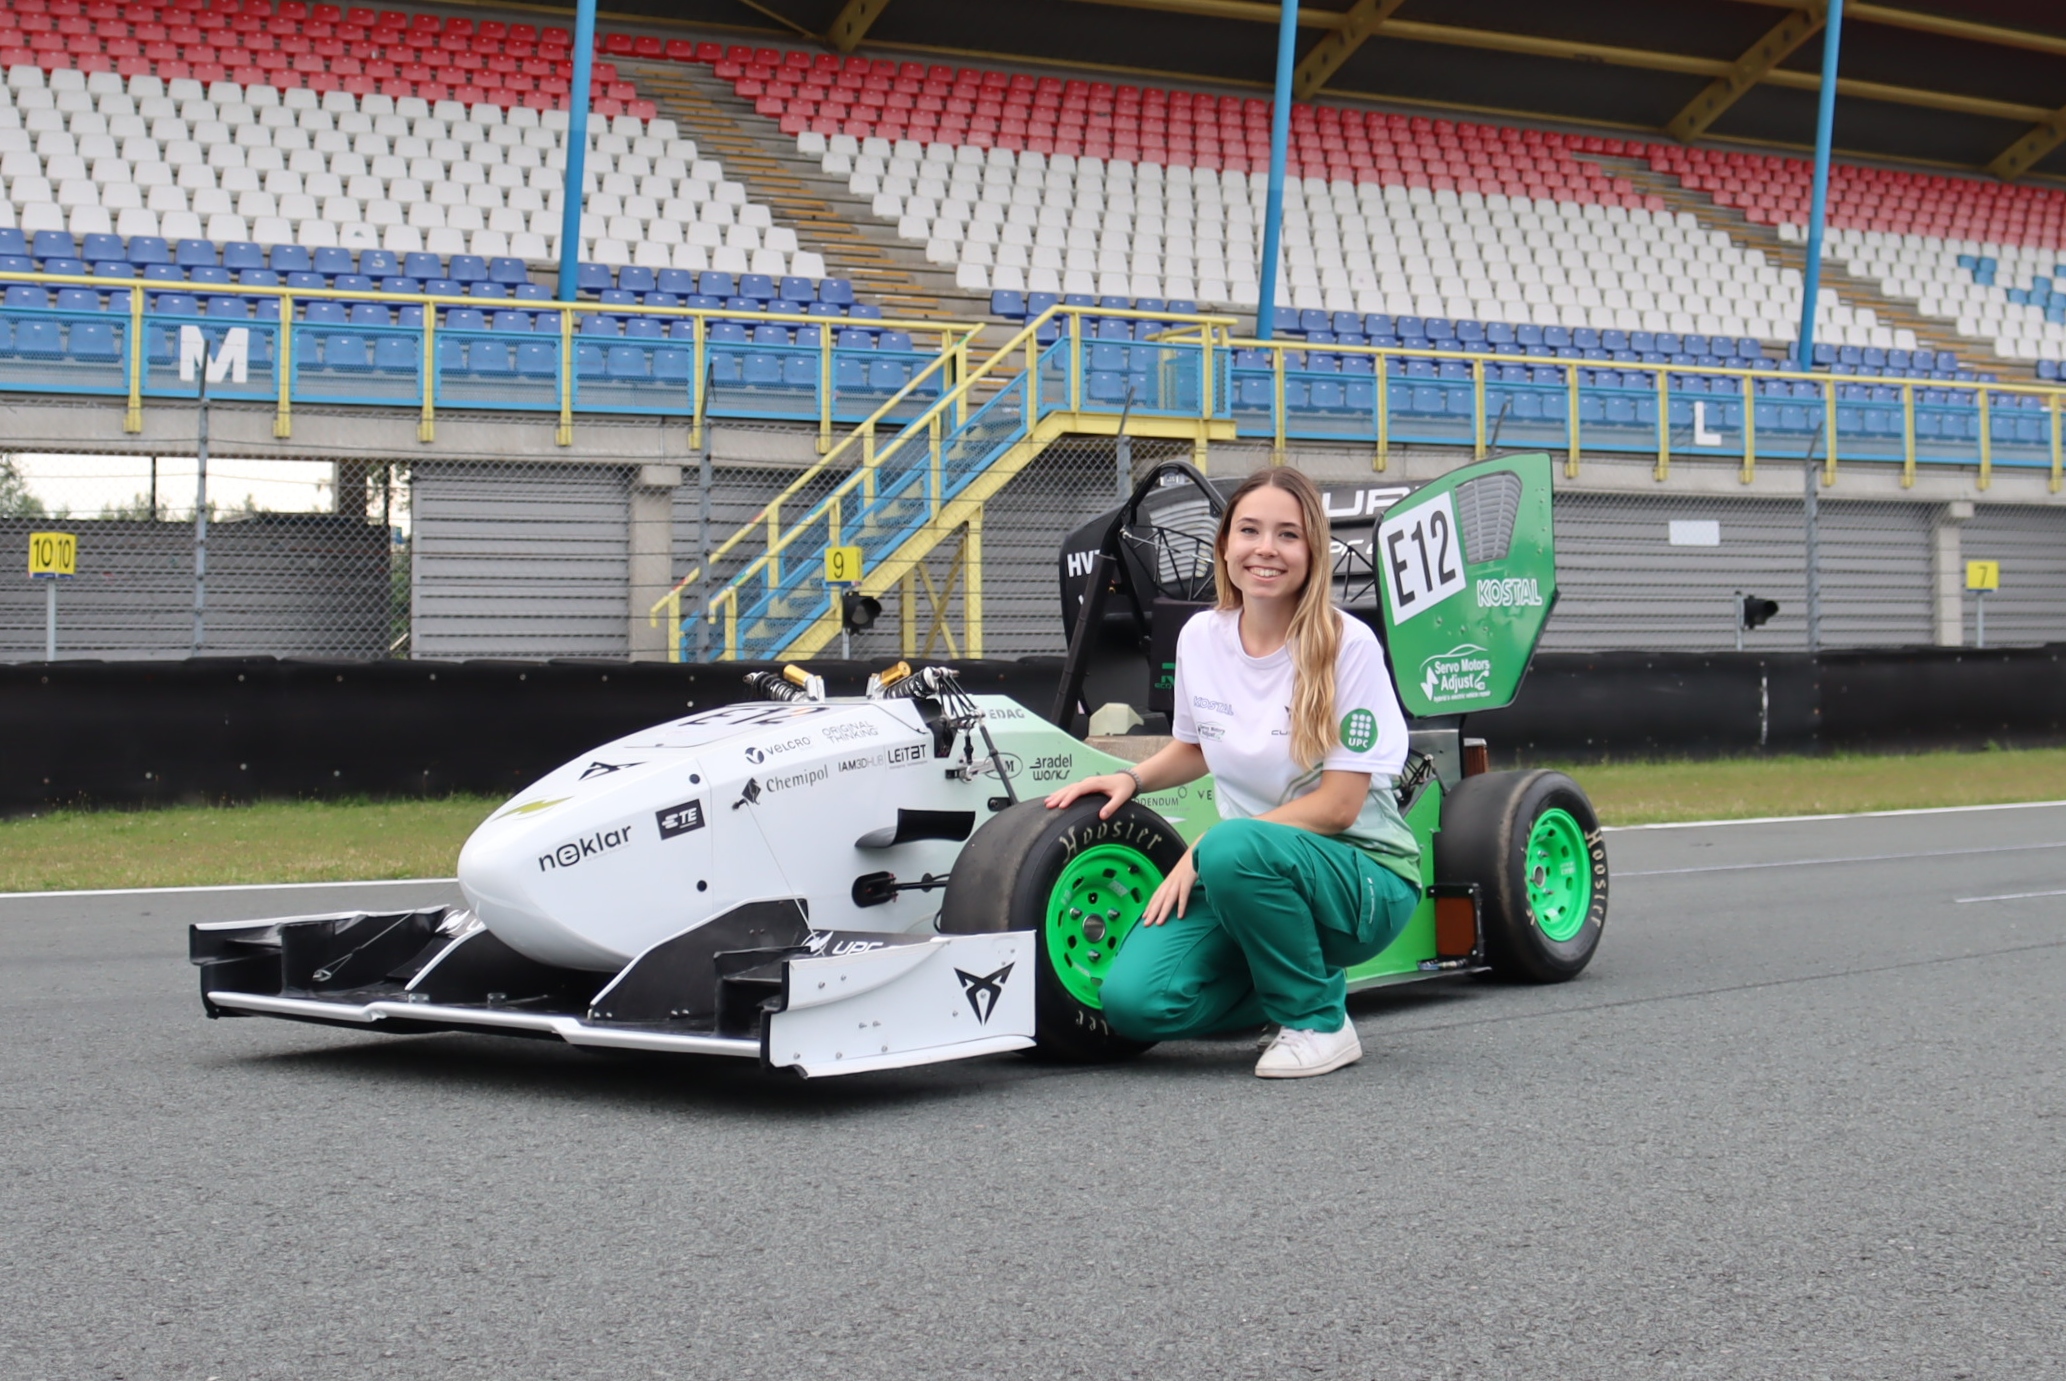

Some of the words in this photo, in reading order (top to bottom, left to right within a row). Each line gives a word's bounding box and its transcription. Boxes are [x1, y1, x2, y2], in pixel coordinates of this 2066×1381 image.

[179, 325, 249, 383] M
[1694, 401, 1722, 446] L
[33, 538, 53, 568] 10
[58, 539, 71, 569] 10
[833, 551, 844, 579] 9
[1387, 510, 1456, 608] E12
[1977, 565, 1988, 586] 7
[1476, 578, 1543, 608] KOSTAL
[1434, 660, 1459, 675] Servo
[1461, 658, 1491, 672] Motors
[1441, 673, 1474, 693] Adjust
[822, 720, 874, 736] ORIGINAL
[989, 708, 1025, 720] EDAG
[1348, 738, 1369, 749] UPC
[766, 764, 829, 793] Chemipol
[538, 825, 632, 872] neklar
